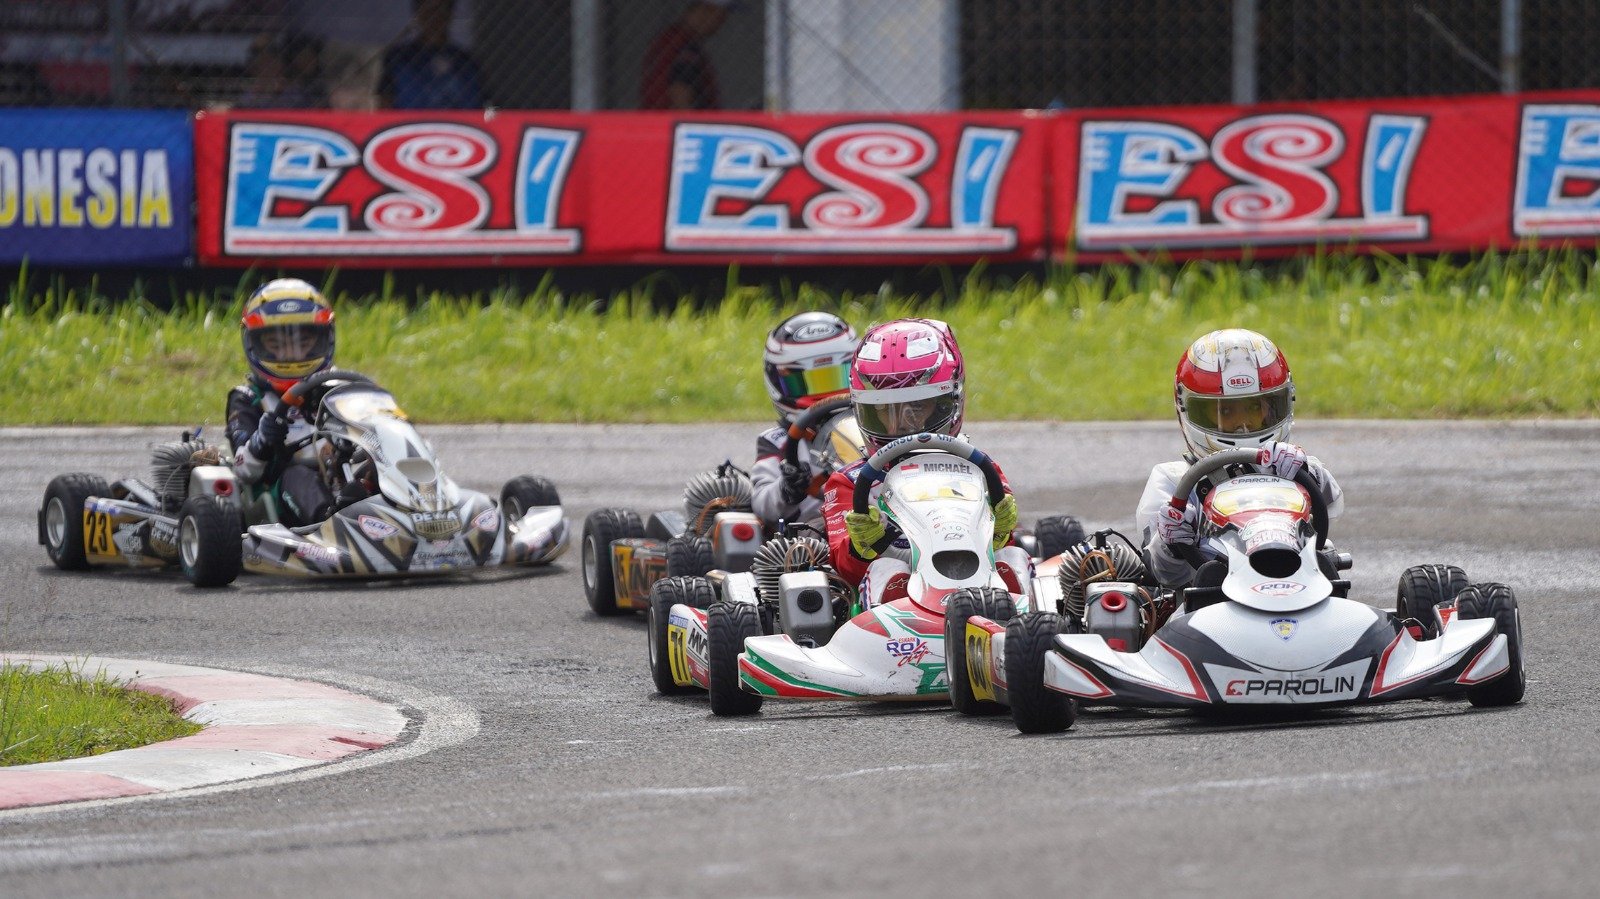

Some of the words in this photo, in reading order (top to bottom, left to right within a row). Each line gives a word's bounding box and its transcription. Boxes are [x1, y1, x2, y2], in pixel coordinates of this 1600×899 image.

[0, 147, 173, 228] ONESIA
[224, 122, 581, 255] ESI
[666, 122, 1018, 251] ESI
[1077, 113, 1428, 248] ESI
[1230, 377, 1251, 385] BELL
[924, 463, 973, 475] MICHAEL
[86, 511, 108, 554] 23
